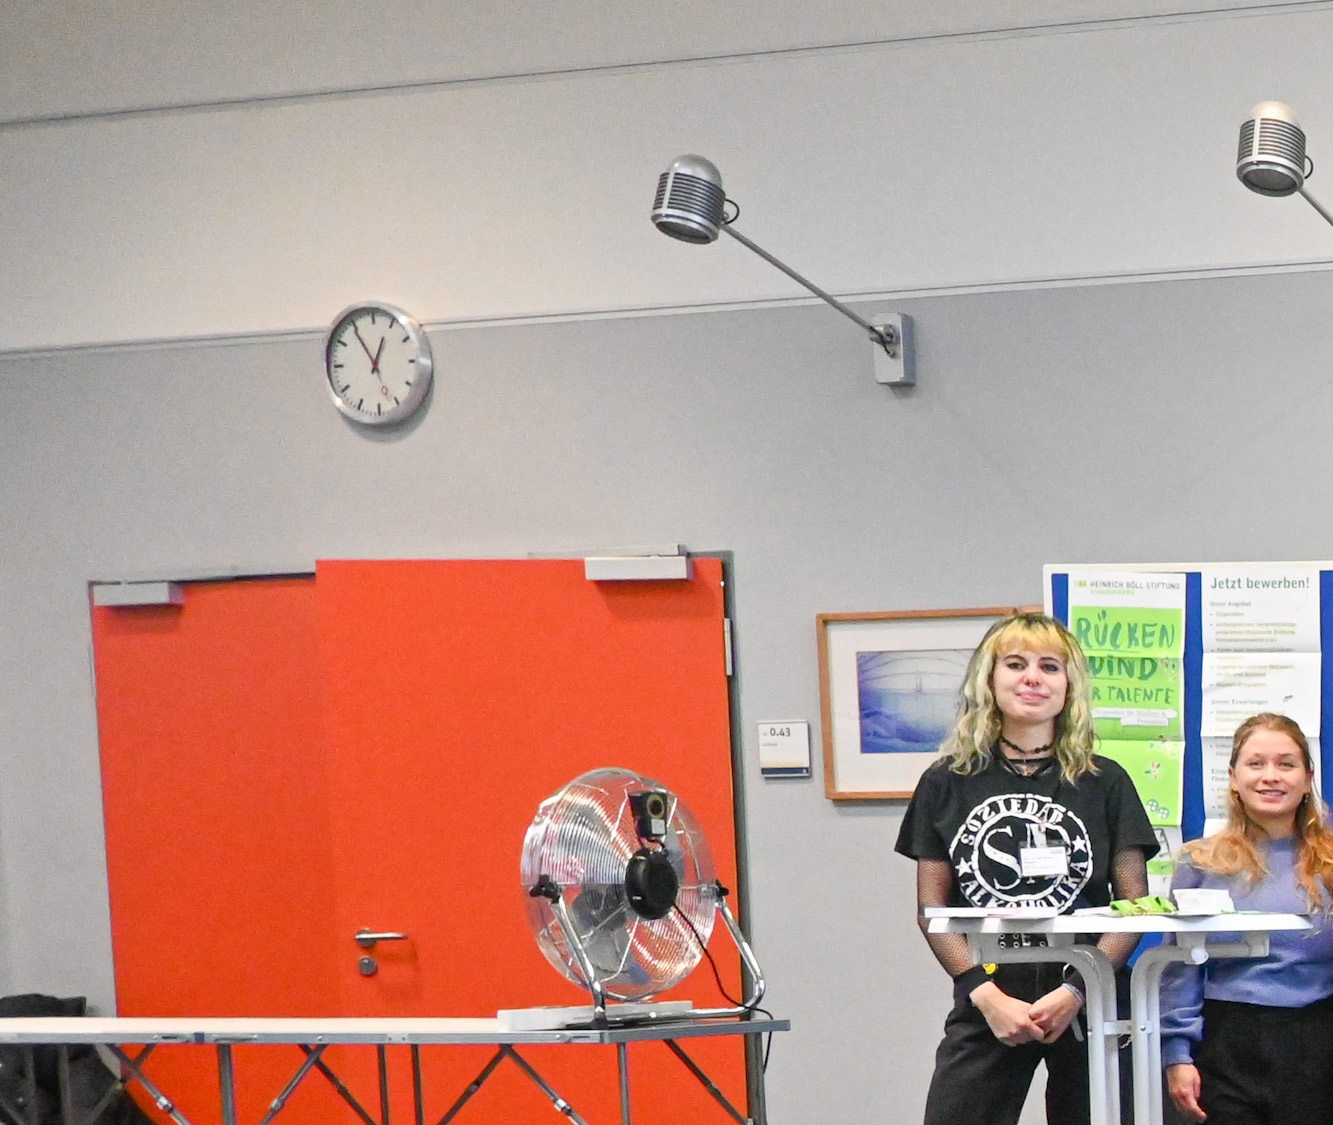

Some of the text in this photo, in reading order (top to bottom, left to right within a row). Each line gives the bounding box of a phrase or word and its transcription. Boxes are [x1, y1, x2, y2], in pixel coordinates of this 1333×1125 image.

[1090, 580, 1124, 588] HEINRICH
[1211, 577, 1310, 589] Jetzt bewerben!
[1077, 609, 1175, 649] RÜCKEN
[1107, 685, 1175, 705] TALENTE
[769, 727, 791, 737] 0.43
